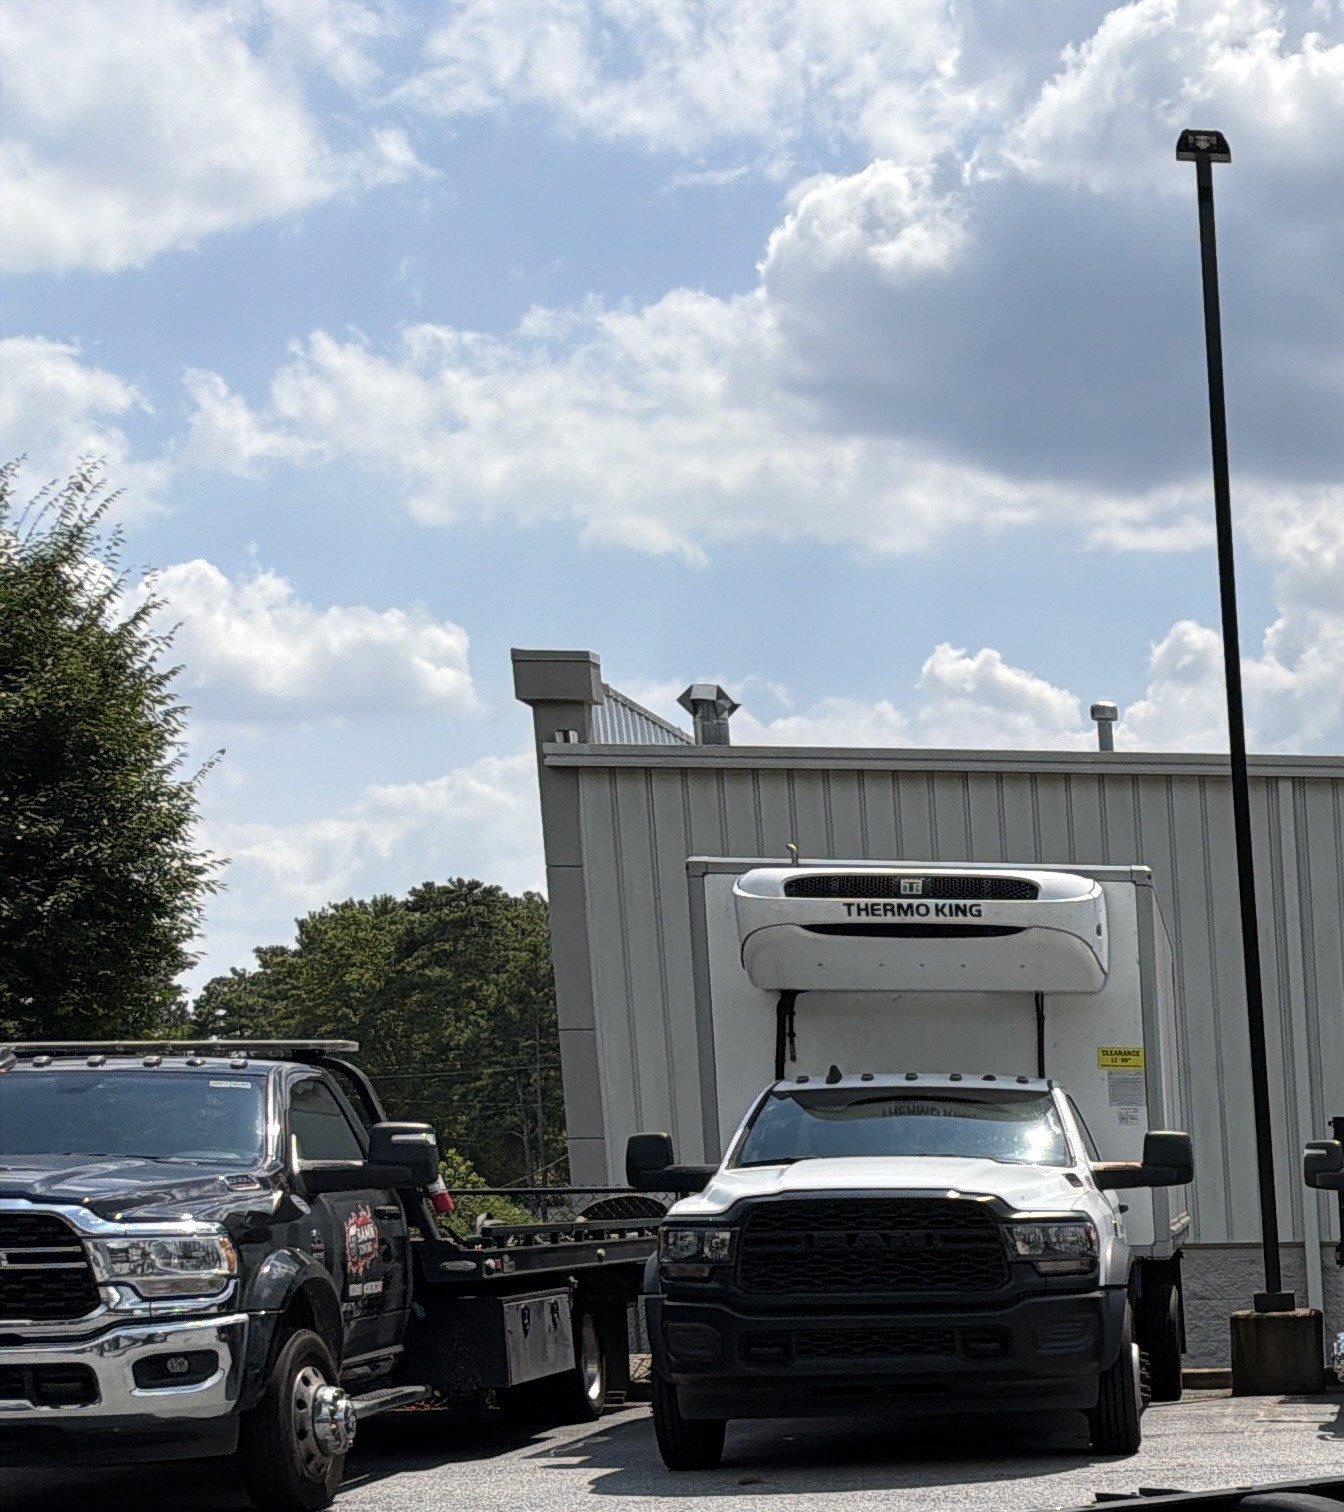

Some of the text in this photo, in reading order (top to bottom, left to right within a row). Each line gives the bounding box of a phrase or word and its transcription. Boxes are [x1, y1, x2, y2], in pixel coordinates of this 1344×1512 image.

[842, 902, 983, 918] THERMO KING
[1101, 1049, 1141, 1057] CLEARANCE
